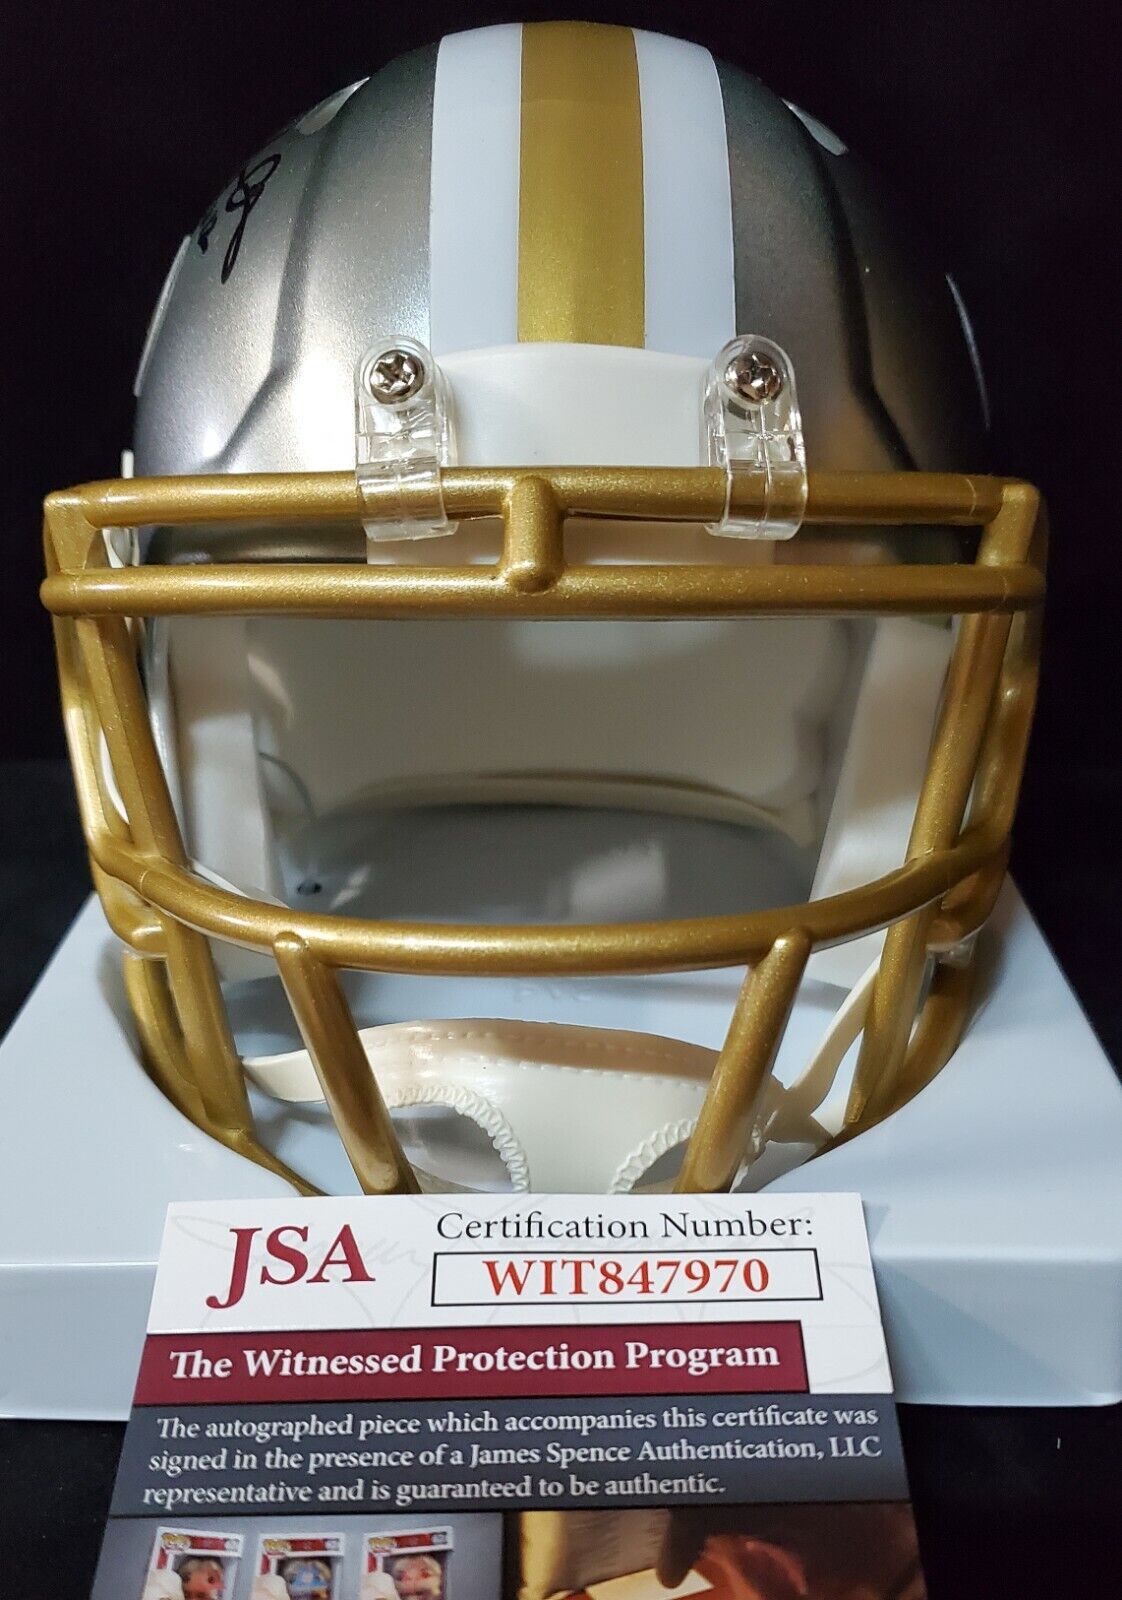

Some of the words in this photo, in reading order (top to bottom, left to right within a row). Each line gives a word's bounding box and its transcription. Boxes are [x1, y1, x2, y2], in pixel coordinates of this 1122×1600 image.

[437, 1210, 649, 1241] Certification
[660, 1210, 814, 1239] Number:
[206, 1224, 377, 1309] JSA
[483, 1258, 770, 1296] WIT847970
[170, 1350, 233, 1378] The
[243, 1345, 422, 1377] Witnessed
[433, 1342, 616, 1373] Protection
[625, 1341, 780, 1376] Program
[157, 1417, 199, 1438] The
[205, 1414, 353, 1442] autographed
[359, 1414, 421, 1439] piece
[427, 1411, 498, 1432] which
[505, 1410, 657, 1436] accompanies
[663, 1407, 707, 1428] this
[712, 1405, 828, 1427] certificate
[833, 1408, 879, 1426] was
[149, 1449, 227, 1476] signed
[233, 1449, 257, 1469] in
[264, 1449, 302, 1469] the
[307, 1449, 413, 1473] presence
[419, 1444, 449, 1466] of
[450, 1450, 464, 1465] a
[470, 1444, 540, 1468] James
[546, 1443, 632, 1466] Spence
[637, 1438, 825, 1462] Authentication,
[830, 1436, 882, 1458] LLC
[143, 1481, 313, 1510] representative
[318, 1479, 364, 1501] and
[371, 1480, 391, 1500] is
[396, 1477, 532, 1505] guaranteed
[538, 1478, 564, 1497] to
[570, 1474, 599, 1496] be
[605, 1473, 726, 1495] authentic.
